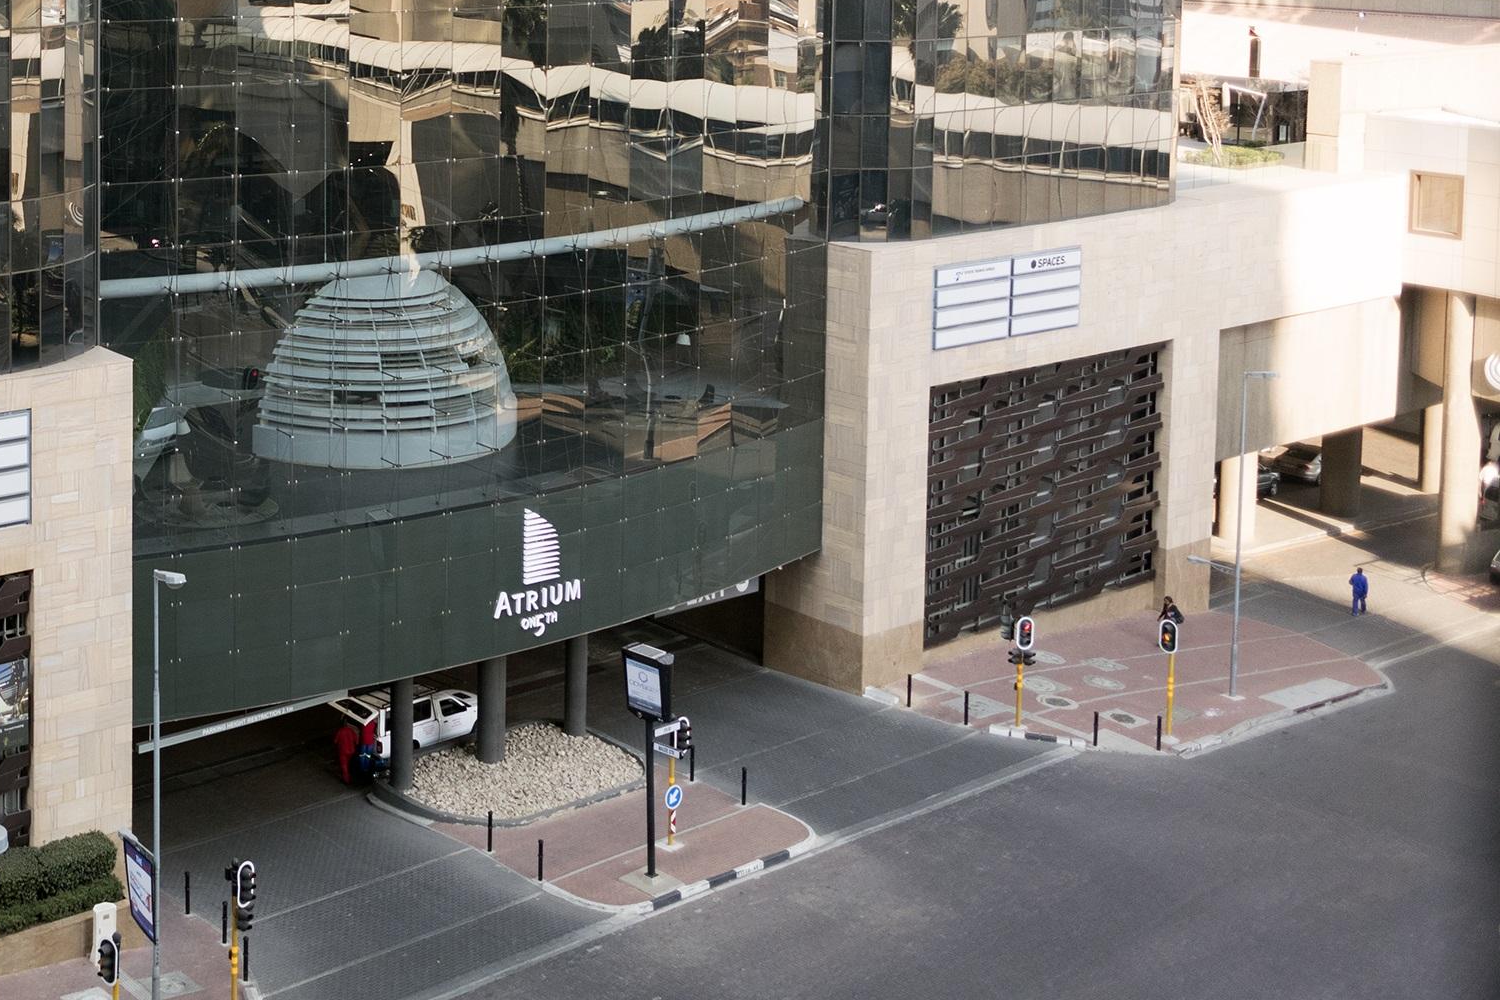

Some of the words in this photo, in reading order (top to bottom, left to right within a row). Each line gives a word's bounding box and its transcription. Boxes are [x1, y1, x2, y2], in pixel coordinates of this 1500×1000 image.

[493, 579, 581, 619] ATRIUM
[202, 723, 226, 735] PARKING
[227, 718, 245, 728] HEIGHT
[246, 709, 281, 722] RESTRICTION
